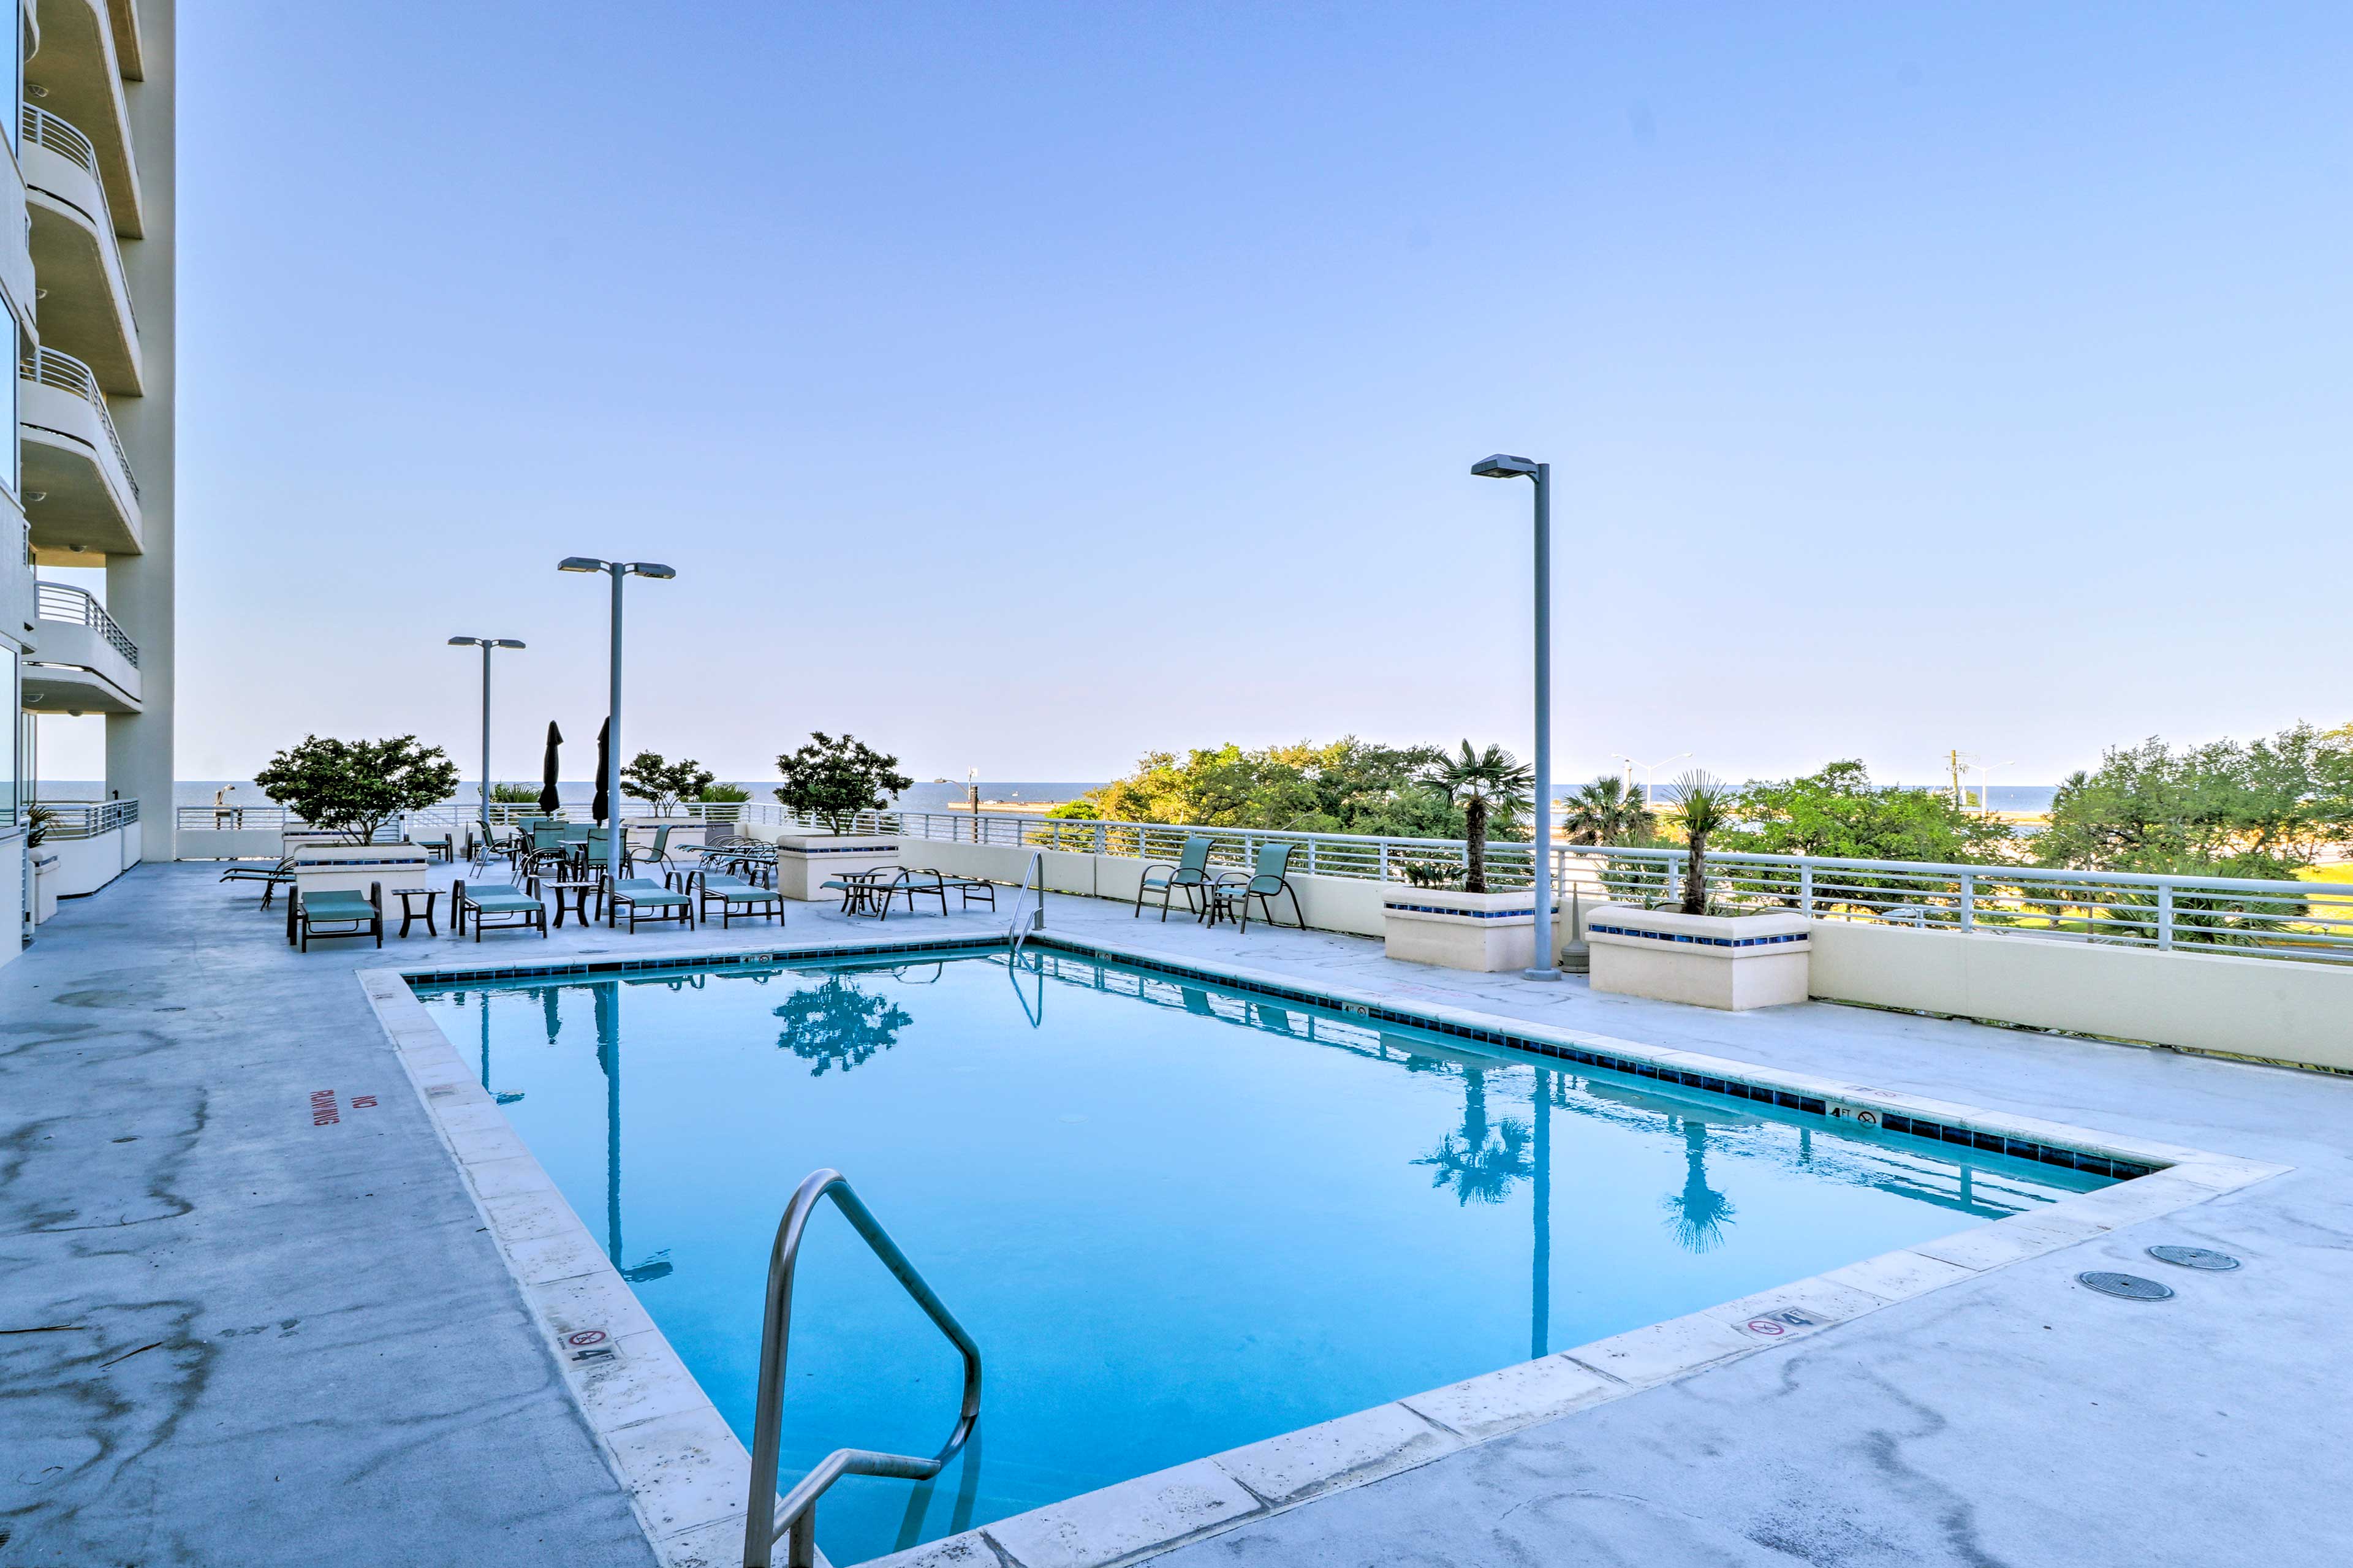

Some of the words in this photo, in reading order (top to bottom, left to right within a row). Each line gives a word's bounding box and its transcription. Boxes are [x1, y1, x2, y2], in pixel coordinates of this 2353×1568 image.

[309, 1089, 340, 1126] RUNNING
[350, 1095, 378, 1108] NO
[1828, 1107, 1840, 1118] 4
[1842, 1108, 1851, 1118] FT
[1781, 1313, 1814, 1325] 4
[572, 1349, 612, 1362] 4
